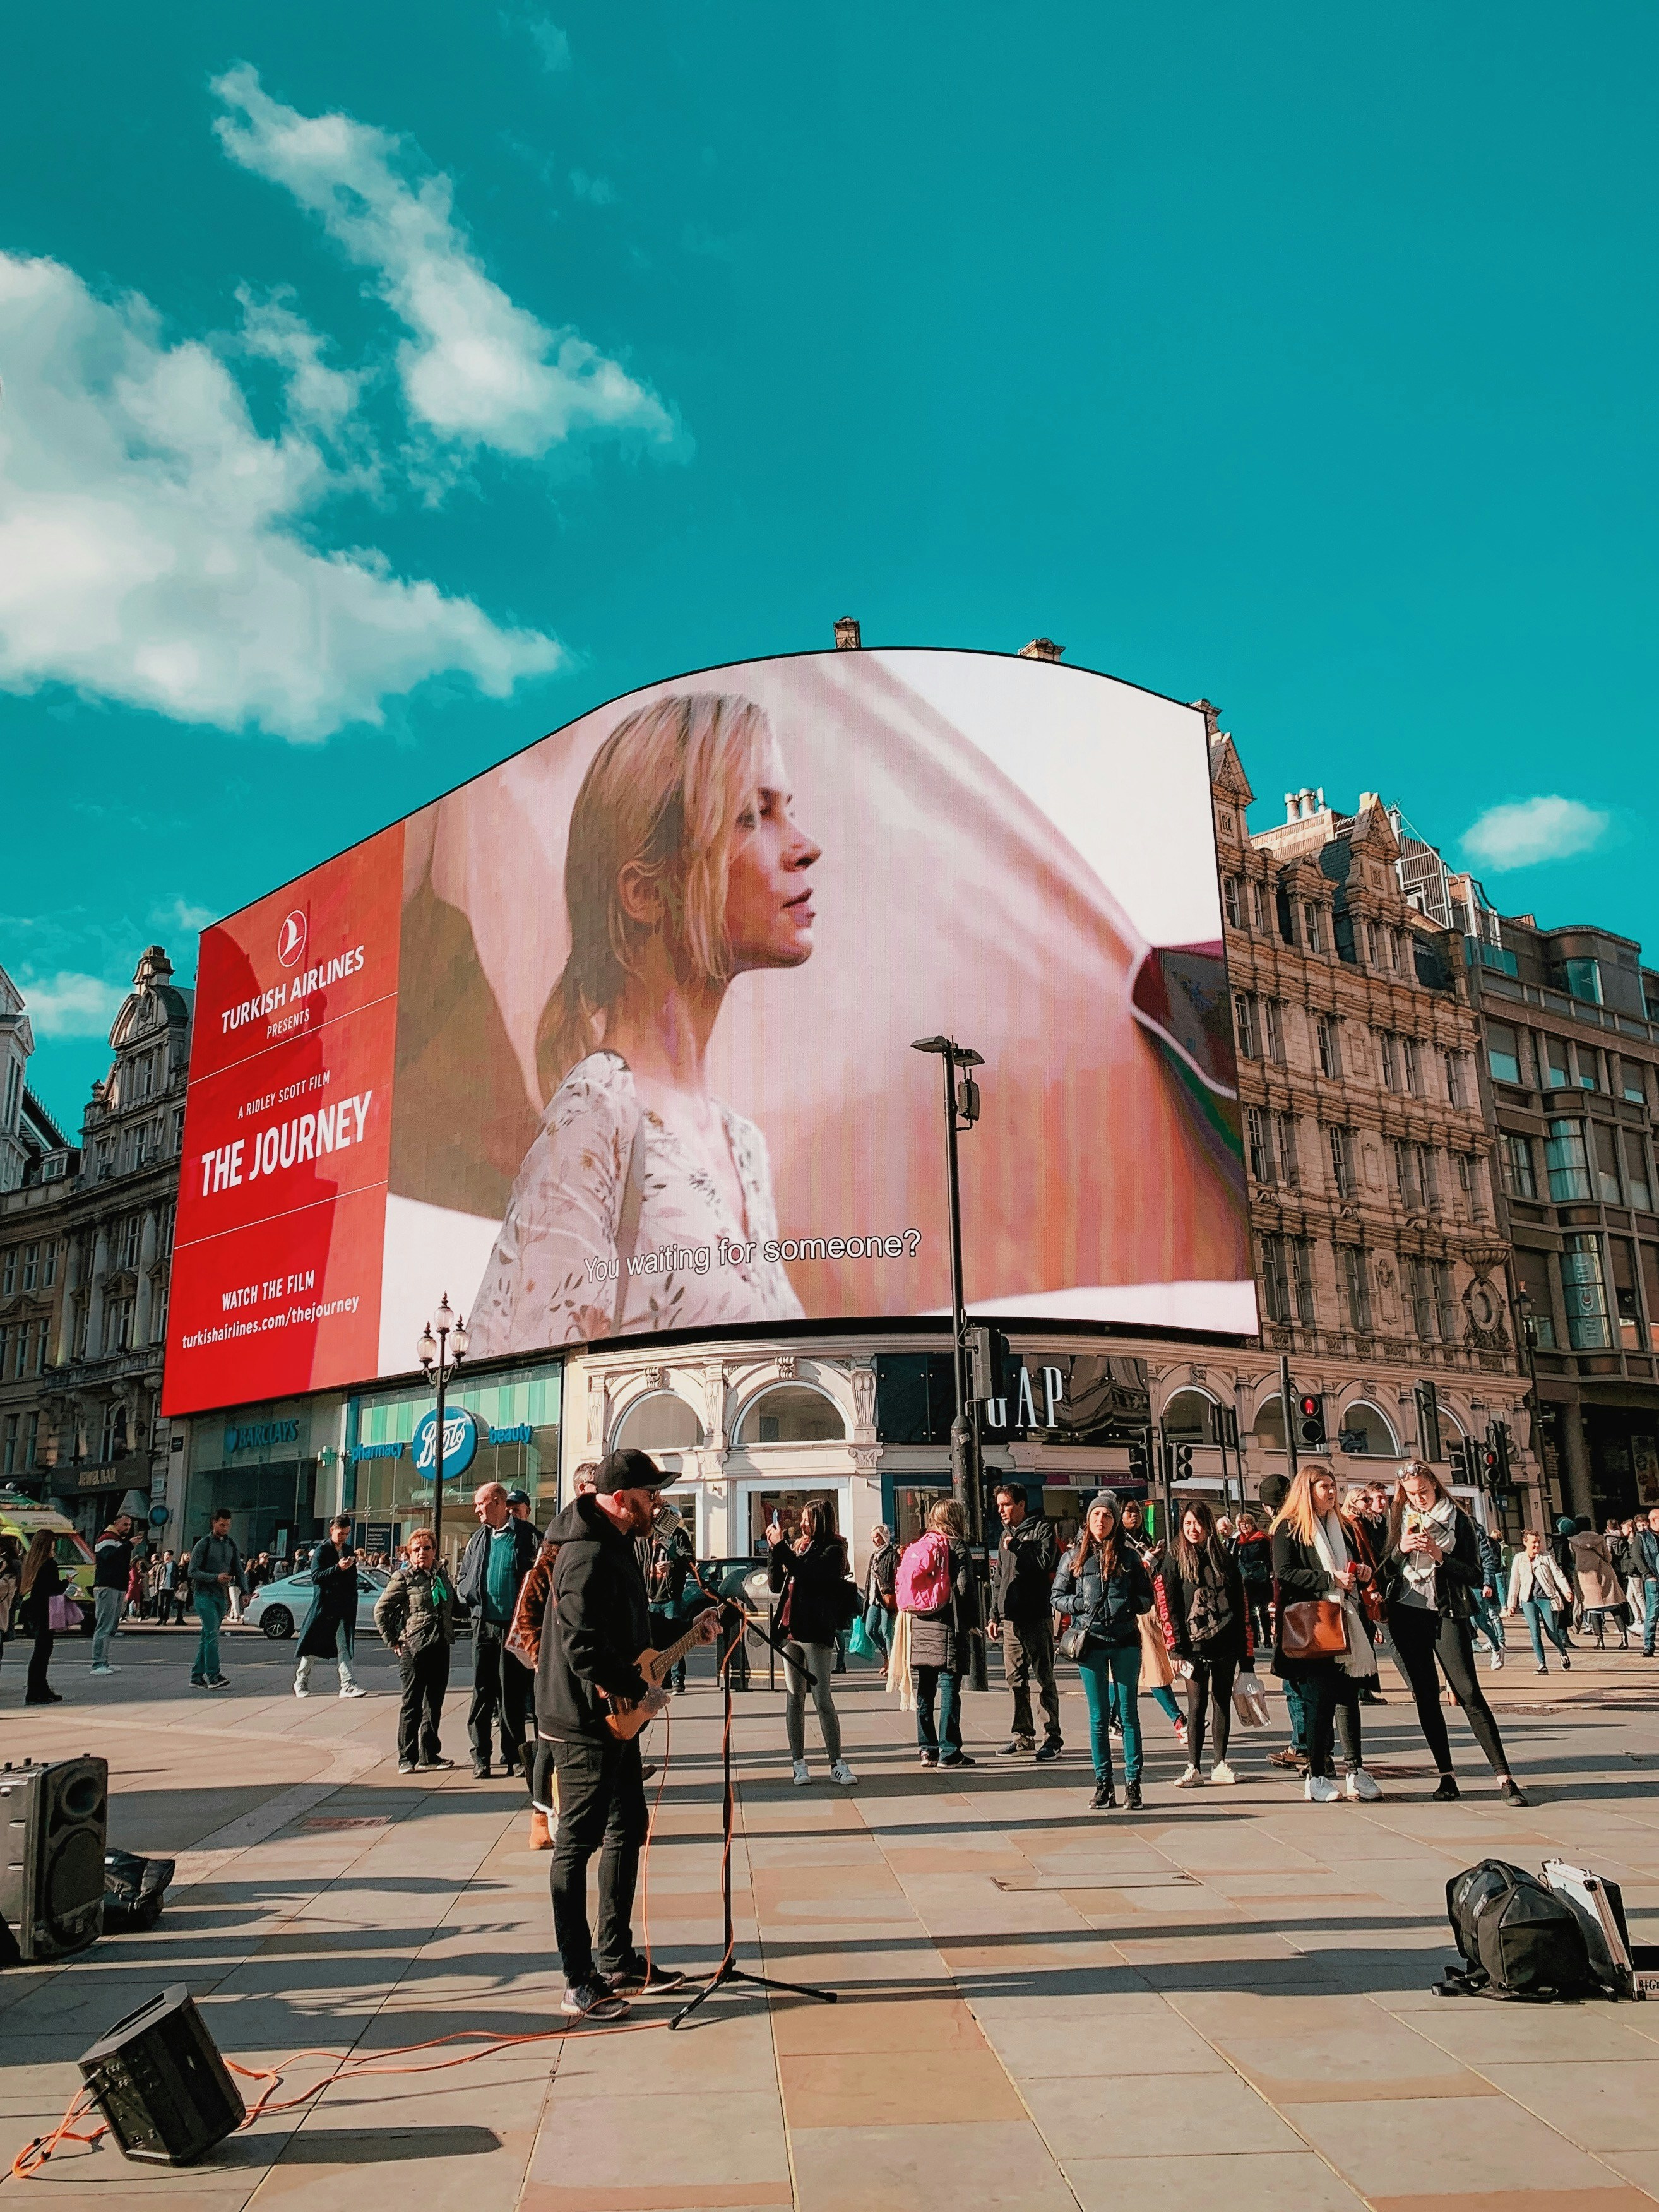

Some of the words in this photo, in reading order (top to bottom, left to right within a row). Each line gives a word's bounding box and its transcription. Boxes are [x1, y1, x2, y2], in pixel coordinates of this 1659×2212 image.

[222, 986, 285, 1033] TURKISH
[290, 945, 364, 1001] AIRLINES
[266, 1008, 310, 1039] PRESENTS
[237, 1106, 244, 1120] A
[246, 1092, 275, 1116] RIDLEY
[278, 1079, 307, 1103] SCOTT
[309, 1070, 330, 1091] FILM
[201, 1139, 244, 1197] THE
[249, 1090, 372, 1180] JOURNEY
[584, 1256, 620, 1283] You
[626, 1244, 710, 1274] waiting
[718, 1238, 756, 1266] for
[764, 1228, 922, 1262] someone?
[222, 1285, 257, 1311] WATCH
[262, 1278, 283, 1302] THE
[287, 1269, 315, 1295] FILM
[182, 1295, 360, 1349] turkishairlines.com/thejourney
[239, 1418, 299, 1448] BARCLAYS
[351, 1442, 405, 1465] pharmacy
[489, 1422, 533, 1445] beauty
[101, 1468, 116, 1484] BAR
